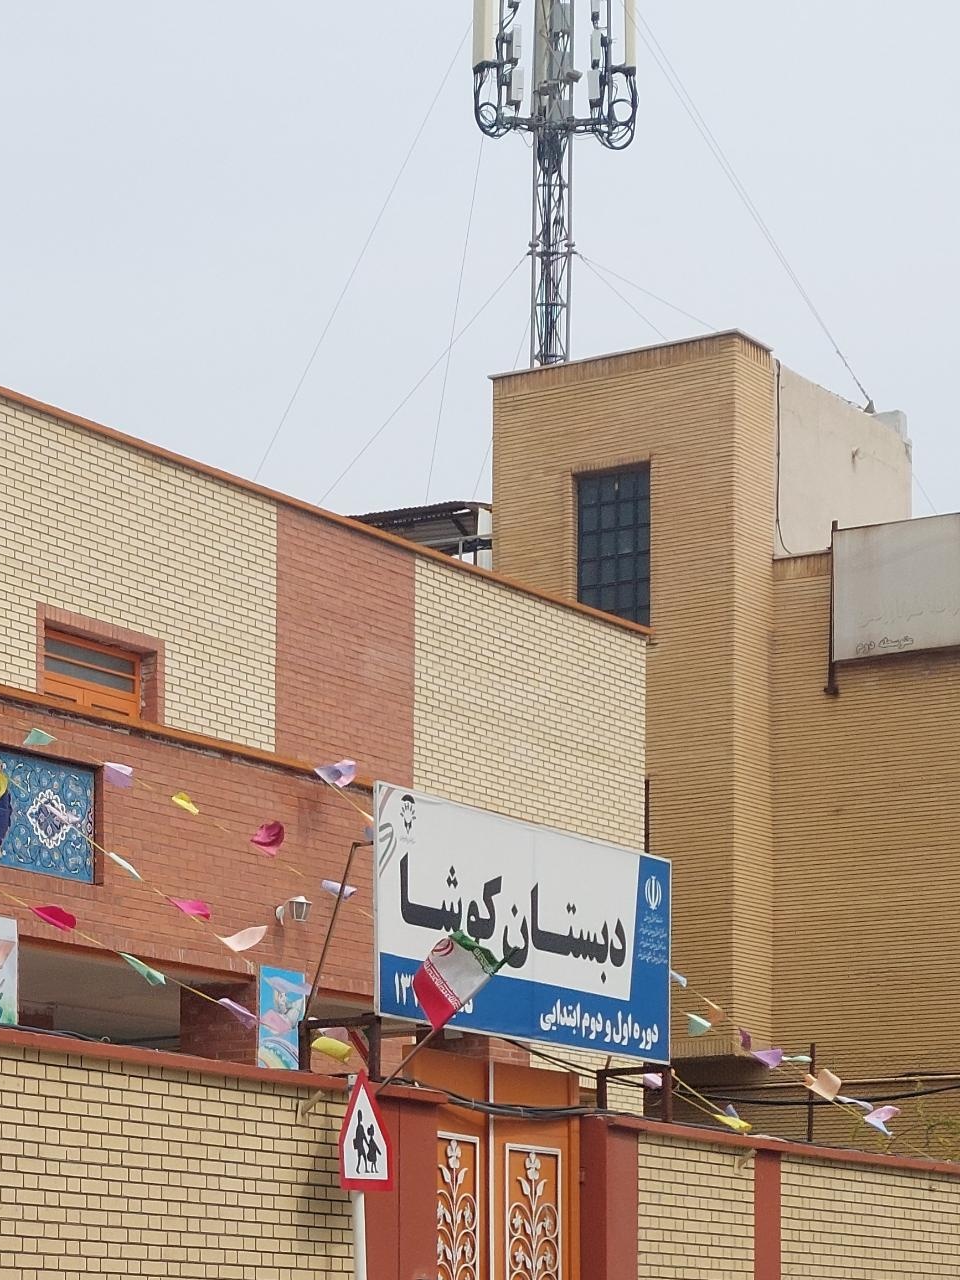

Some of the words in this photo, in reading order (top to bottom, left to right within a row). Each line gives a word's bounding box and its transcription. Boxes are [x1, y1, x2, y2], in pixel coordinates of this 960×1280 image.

[399, 851, 502, 945] کوشا
[502, 881, 627, 985] دبستان
[539, 998, 581, 1035] ابتدایی
[581, 1012, 603, 1040] دوم
[604, 1019, 613, 1043] و
[613, 1010, 633, 1046] اول
[633, 1022, 659, 1051] دوره
